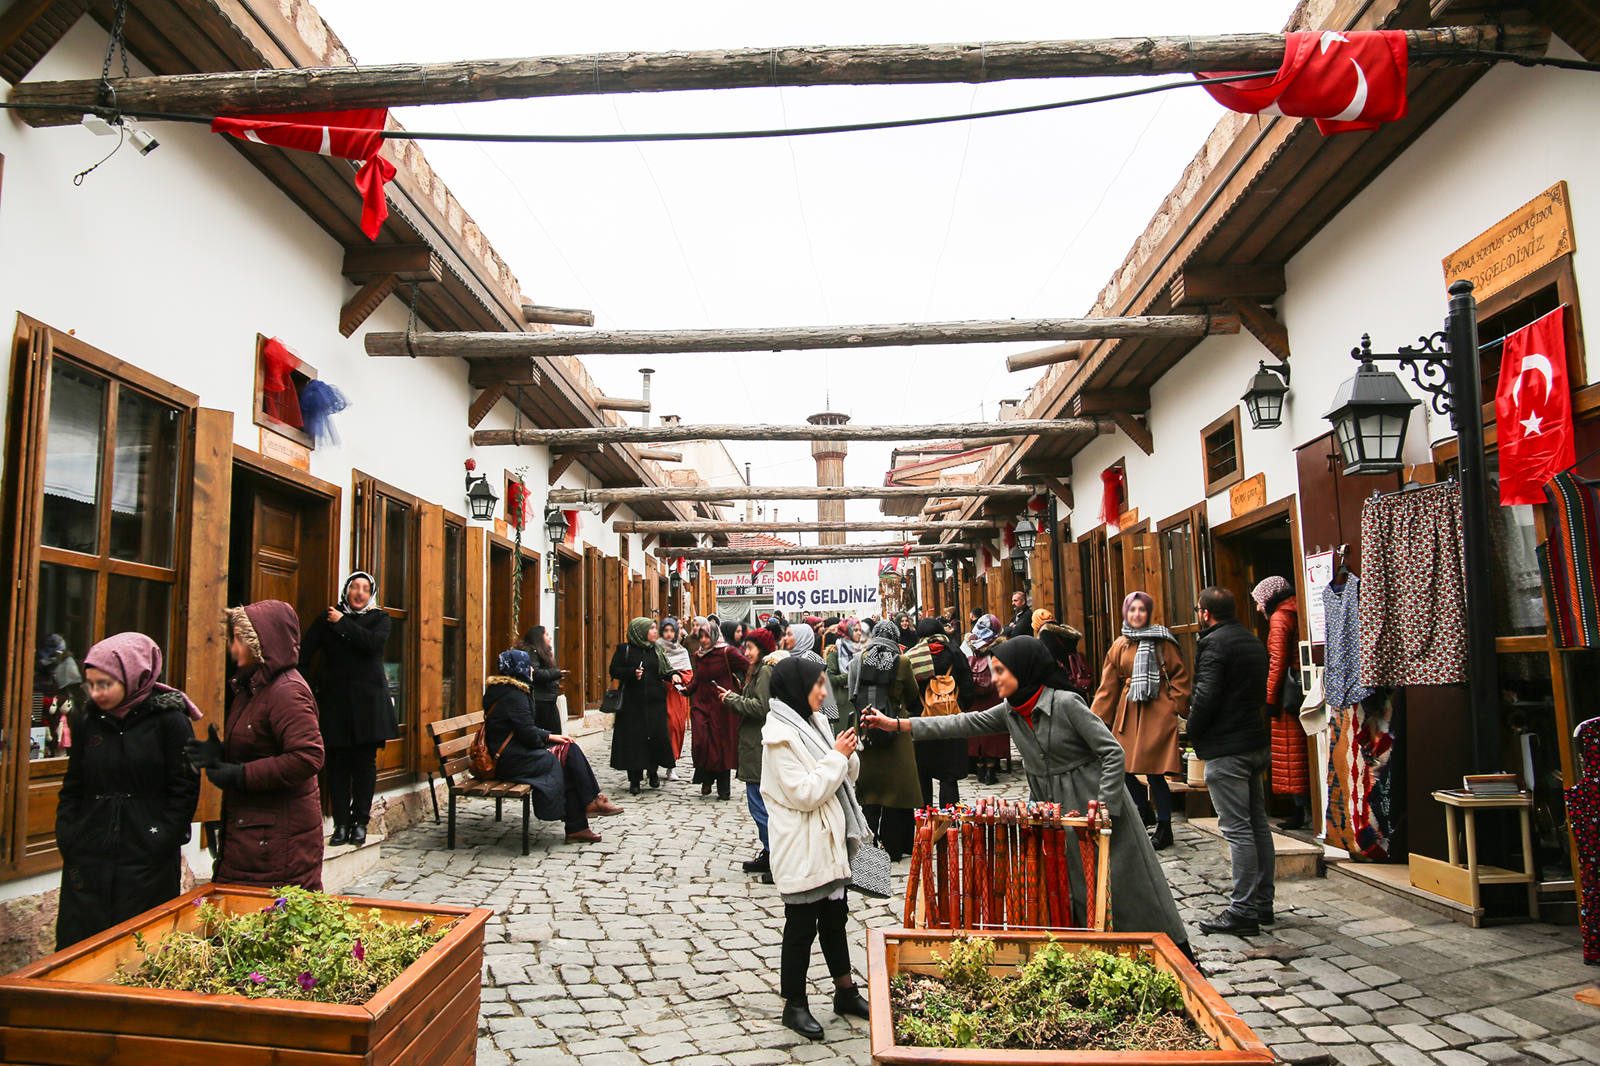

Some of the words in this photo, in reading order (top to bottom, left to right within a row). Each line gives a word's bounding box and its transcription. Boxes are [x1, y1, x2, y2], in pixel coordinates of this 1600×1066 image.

[776, 567, 819, 583] SOKAĞI
[776, 590, 807, 609] HOŞ
[810, 584, 877, 605] GELDİNİZ
